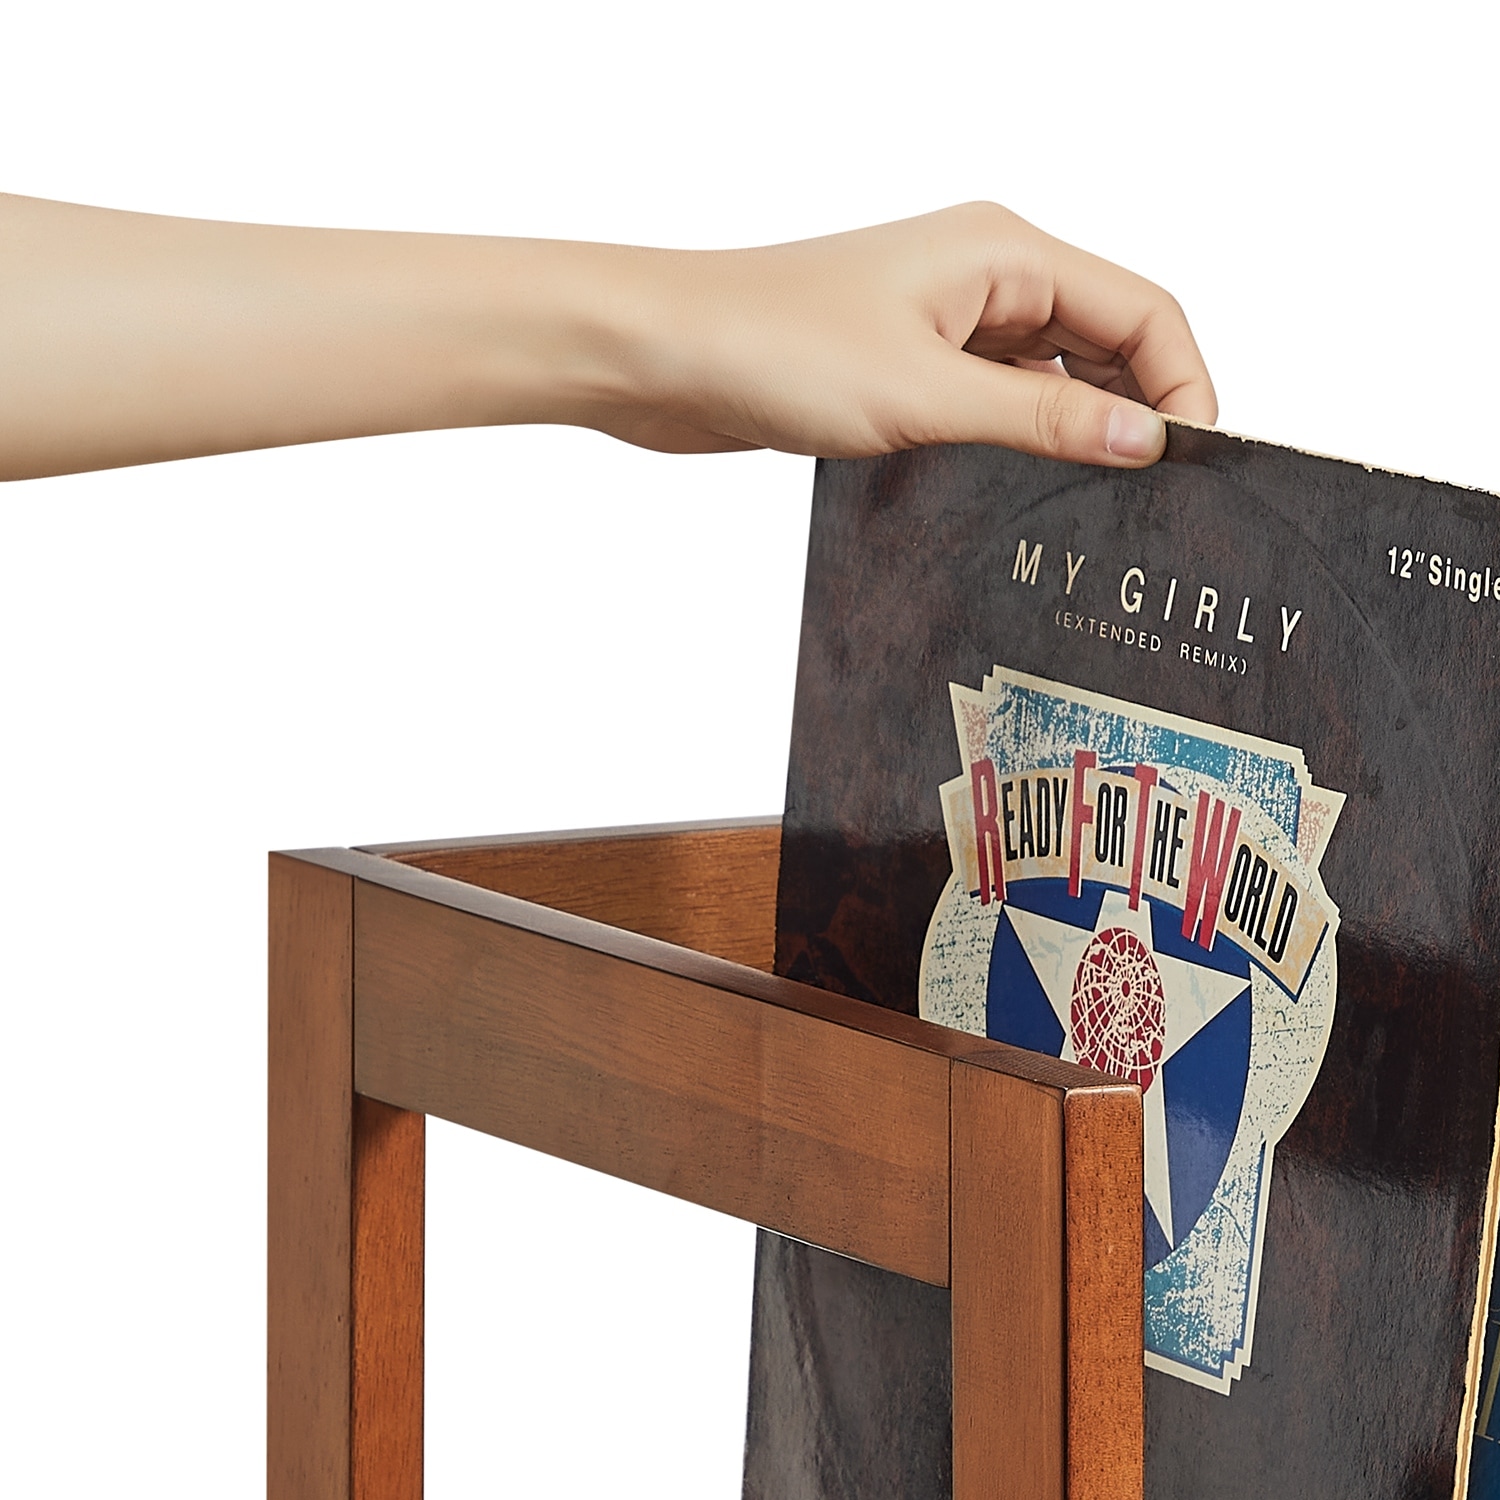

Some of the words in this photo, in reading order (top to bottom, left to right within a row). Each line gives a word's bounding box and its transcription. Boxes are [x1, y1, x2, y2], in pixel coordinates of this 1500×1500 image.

[1010, 537, 1087, 596] MY
[1119, 565, 1304, 652] GIRLY
[1054, 611, 1163, 653] (EXTENDED
[1178, 641, 1249, 676] REMIX)
[971, 758, 1070, 906] READY
[1067, 749, 1128, 899] FOR
[1127, 762, 1189, 911] THE
[1180, 789, 1299, 965] WORLD
